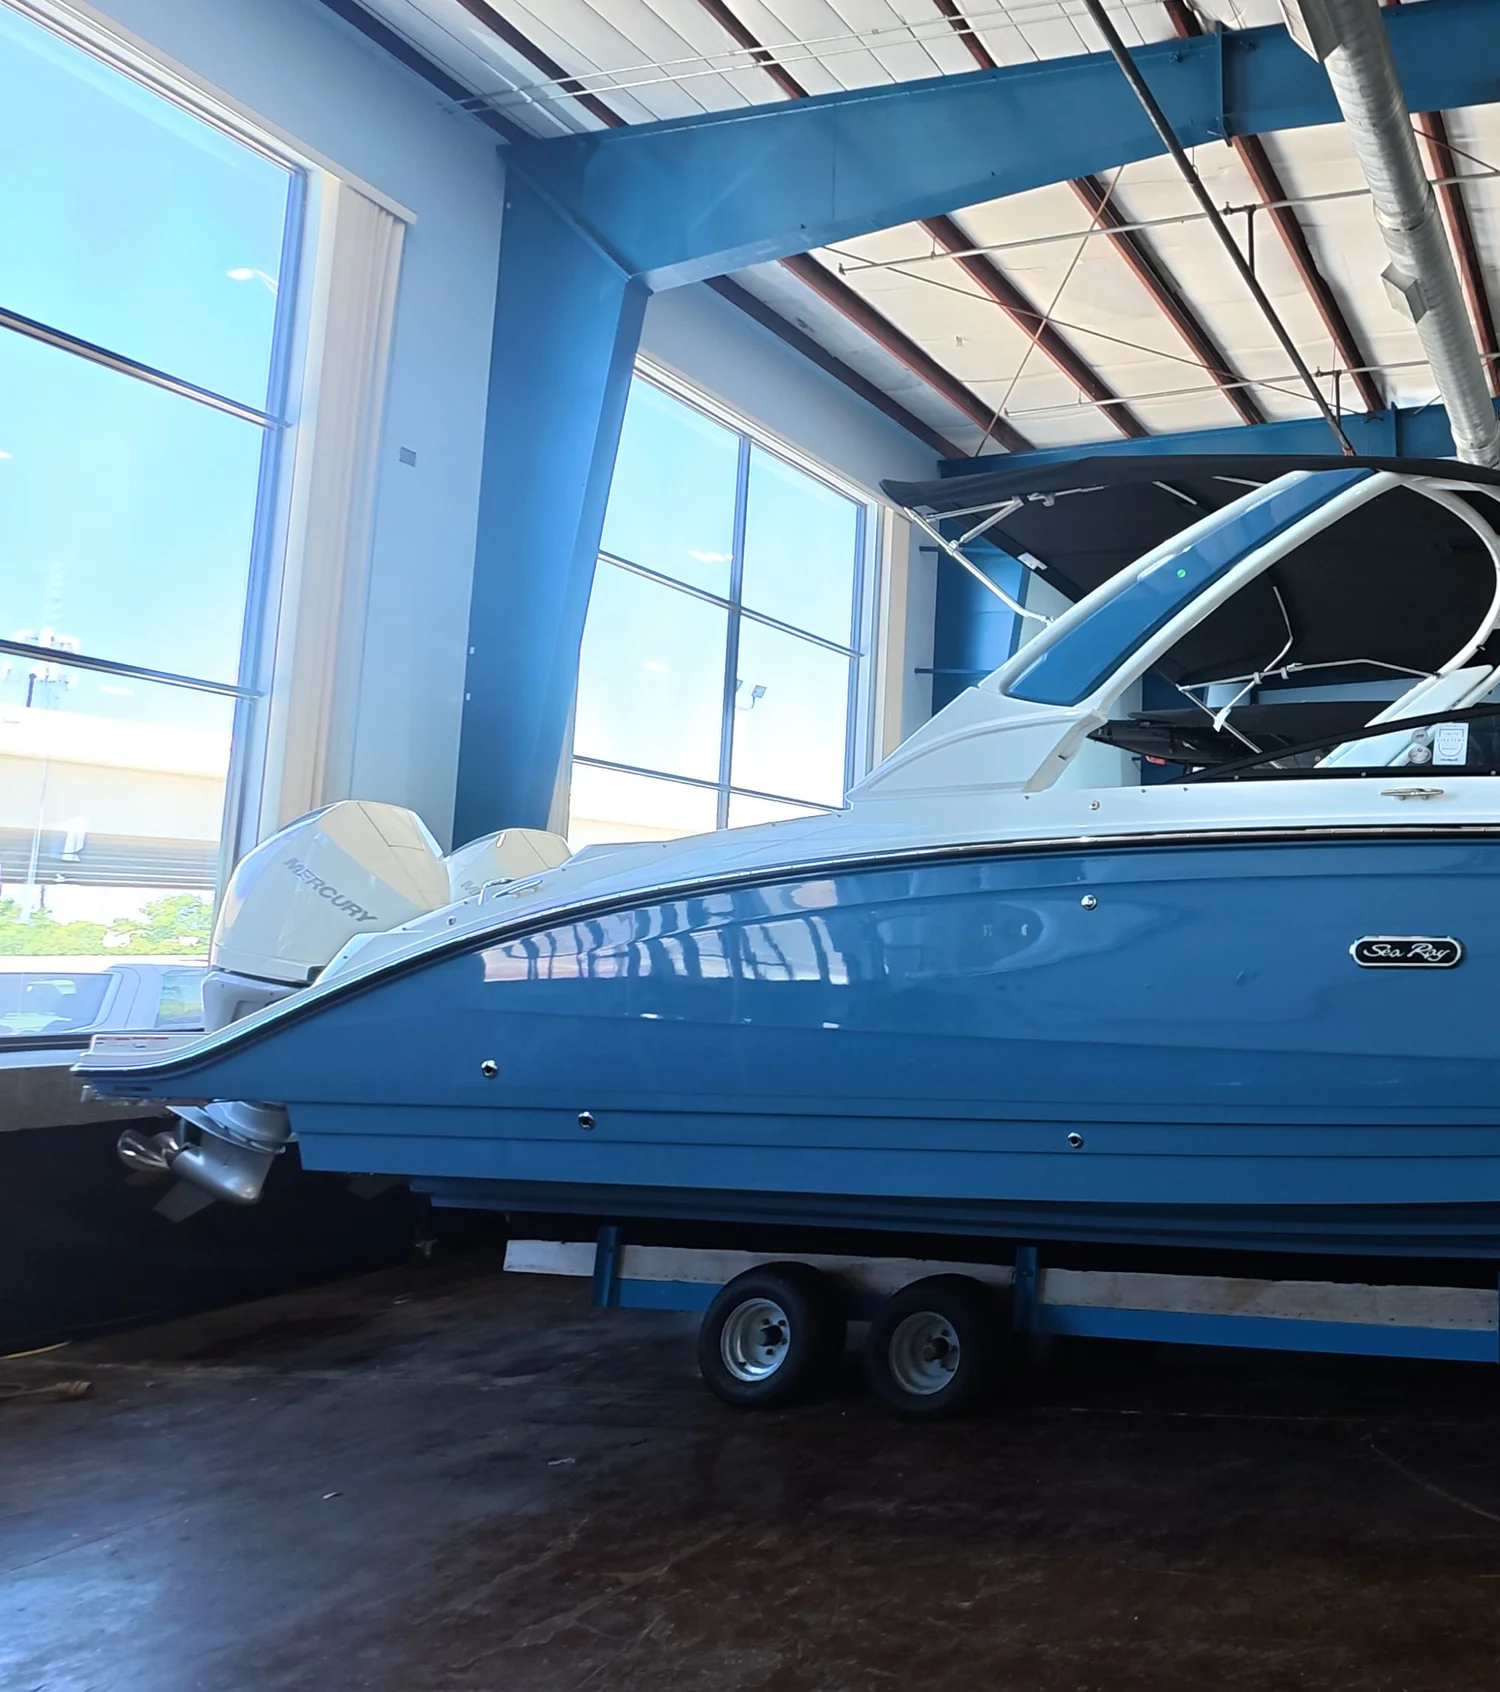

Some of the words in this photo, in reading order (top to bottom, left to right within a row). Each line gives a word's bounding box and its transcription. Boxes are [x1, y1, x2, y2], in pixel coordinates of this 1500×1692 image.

[284, 857, 378, 922] MERCURY
[1363, 944, 1405, 957] Sea
[1407, 943, 1450, 961] Ray
